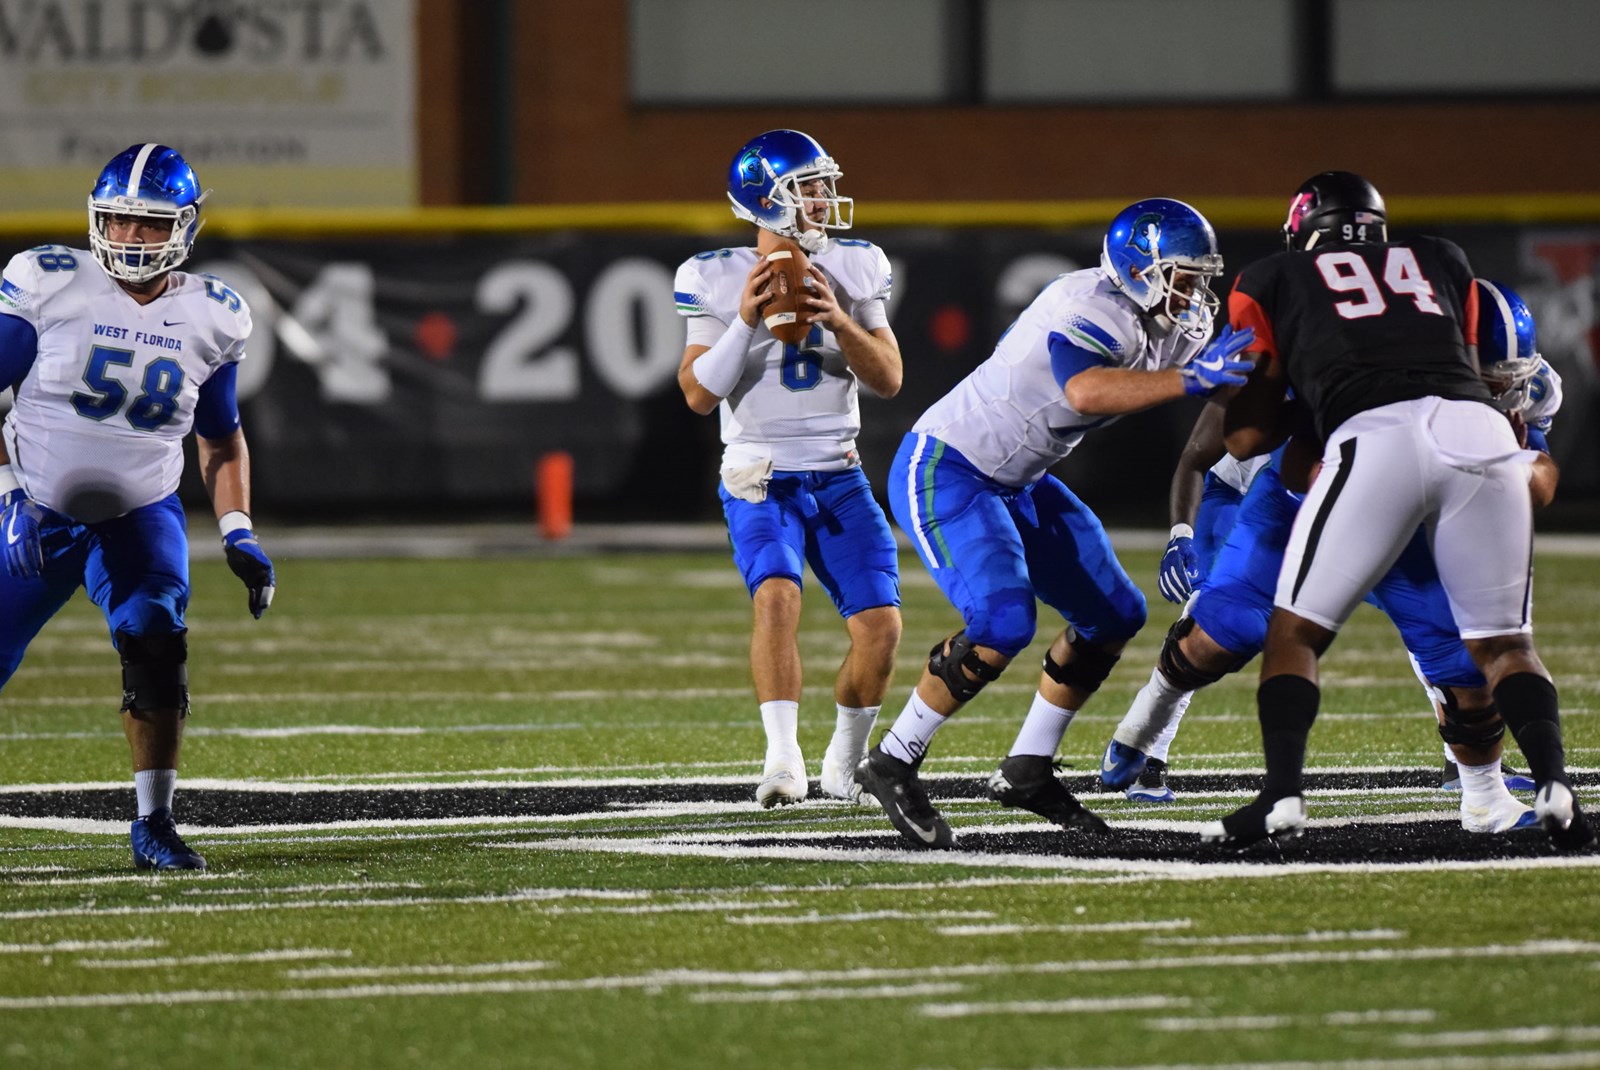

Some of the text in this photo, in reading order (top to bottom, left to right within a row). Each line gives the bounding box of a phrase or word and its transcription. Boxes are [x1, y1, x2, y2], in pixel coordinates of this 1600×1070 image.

[1342, 224, 1367, 241] 94
[1315, 246, 1444, 320] 94
[94, 323, 182, 351] WEST FLORIDA
[779, 322, 824, 393] 6
[69, 344, 186, 432] 58
